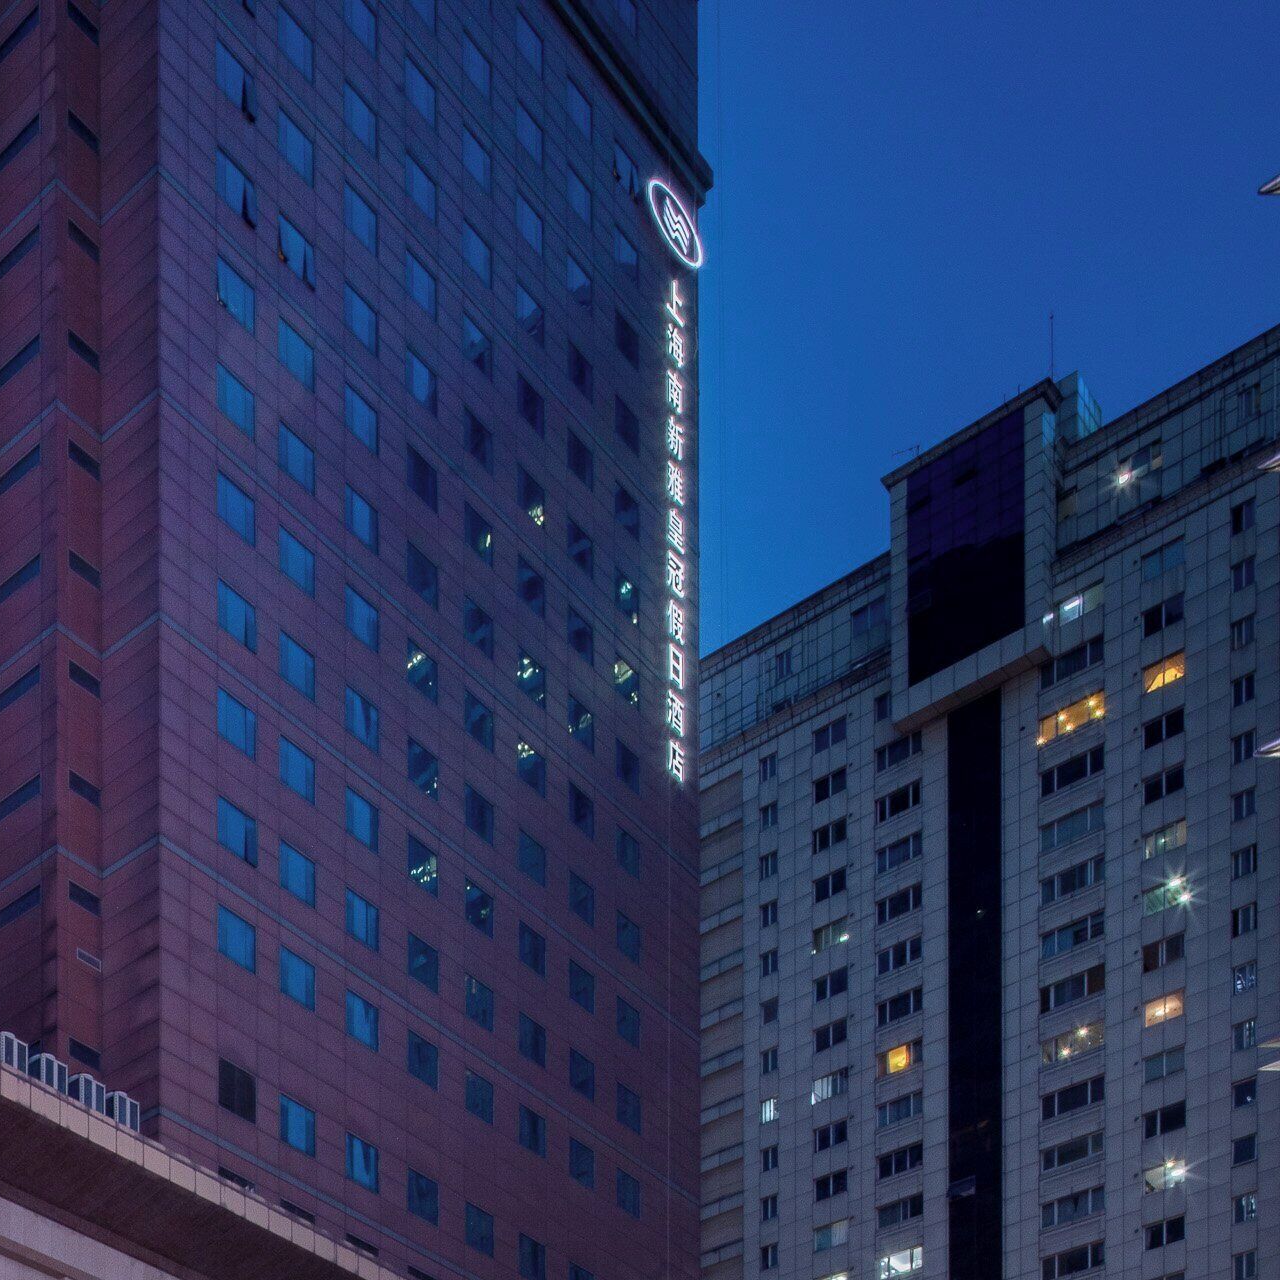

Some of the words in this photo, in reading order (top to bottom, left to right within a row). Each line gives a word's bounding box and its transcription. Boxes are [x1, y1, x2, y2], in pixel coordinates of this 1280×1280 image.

[666, 279, 685, 783] 上海南新雅皇冠假日酒店
